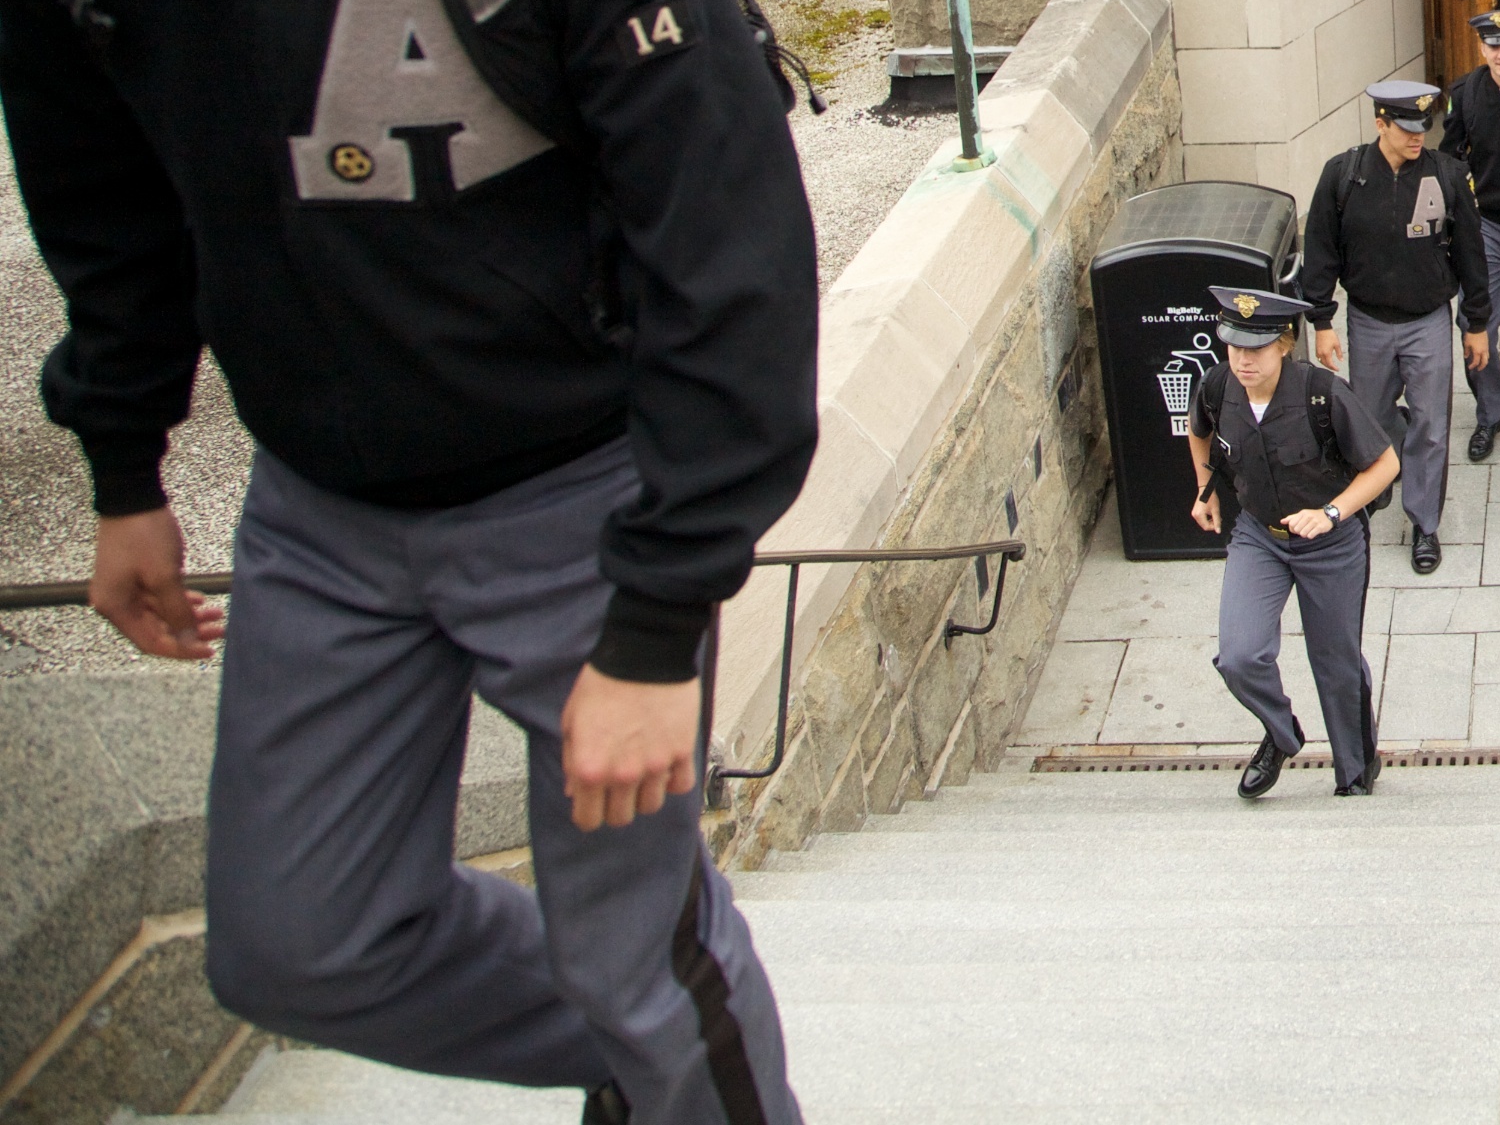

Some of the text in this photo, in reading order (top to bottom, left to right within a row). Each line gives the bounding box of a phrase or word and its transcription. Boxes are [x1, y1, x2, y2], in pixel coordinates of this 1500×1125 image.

[627, 6, 684, 56] 14
[1407, 176, 1446, 239] A
[1142, 314, 1219, 323] SOLAR COMPACT
[1166, 306, 1203, 316] BigBelly
